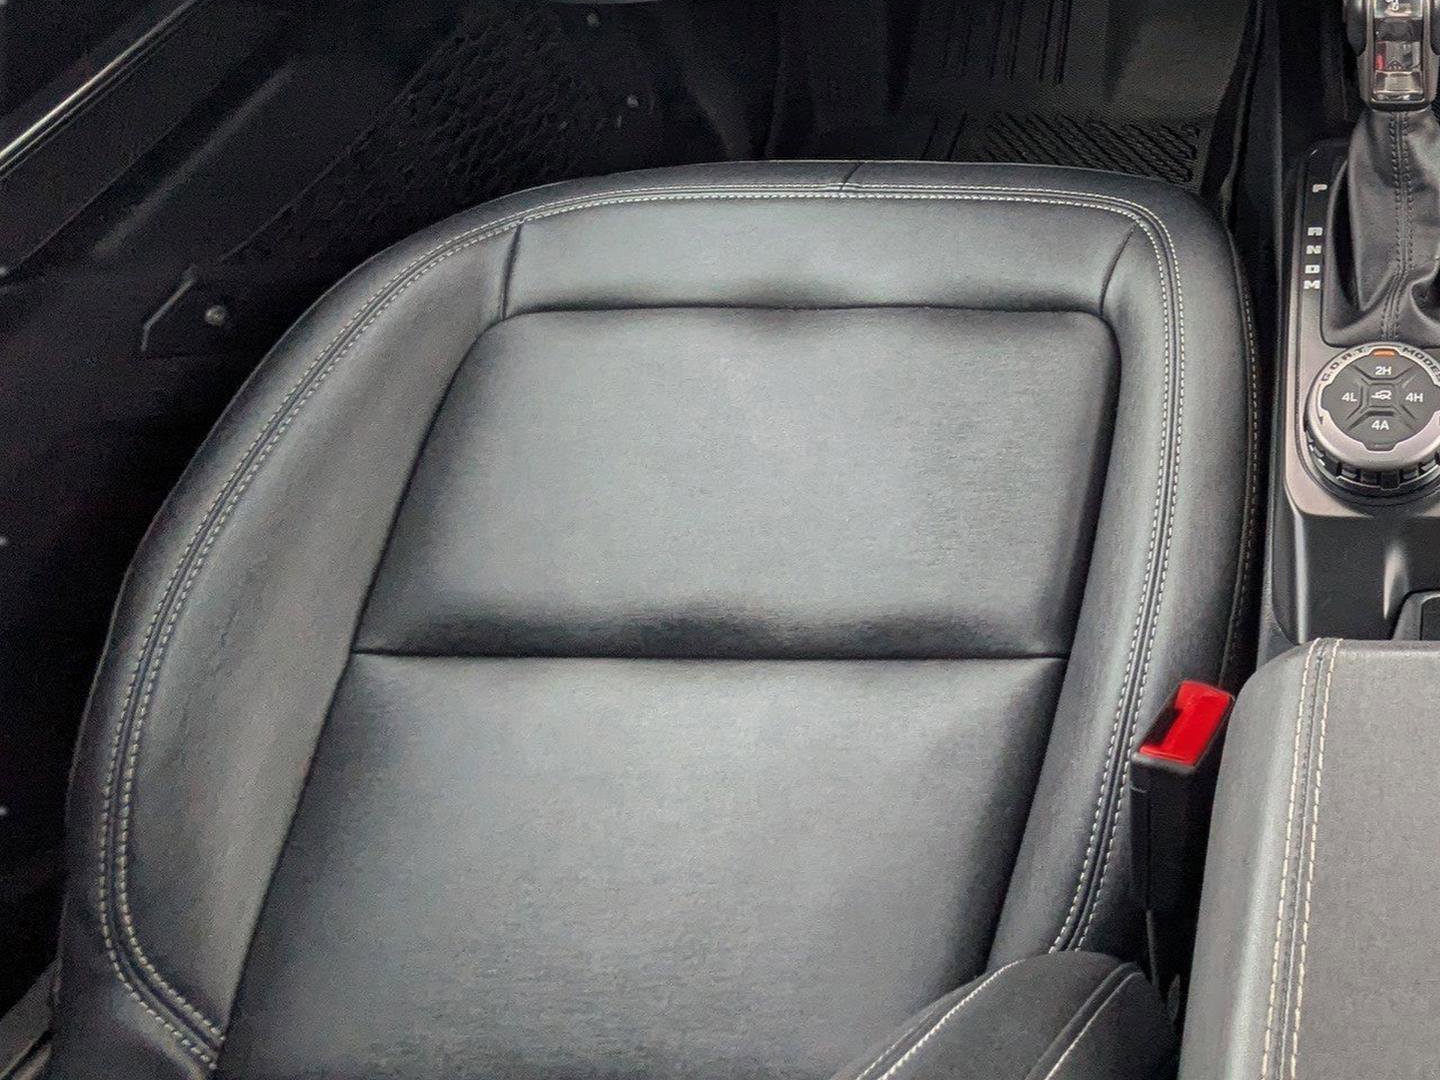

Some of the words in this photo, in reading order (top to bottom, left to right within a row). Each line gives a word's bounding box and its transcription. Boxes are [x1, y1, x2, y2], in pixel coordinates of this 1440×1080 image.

[1312, 183, 1328, 193] P
[1307, 227, 1323, 236] R
[1306, 245, 1322, 255] N
[1304, 264, 1320, 274] D
[1303, 280, 1321, 290] M
[1375, 366, 1392, 375] 2H
[1341, 392, 1357, 402] 4L
[1405, 392, 1424, 402] 4H
[1371, 420, 1390, 430] 4A
